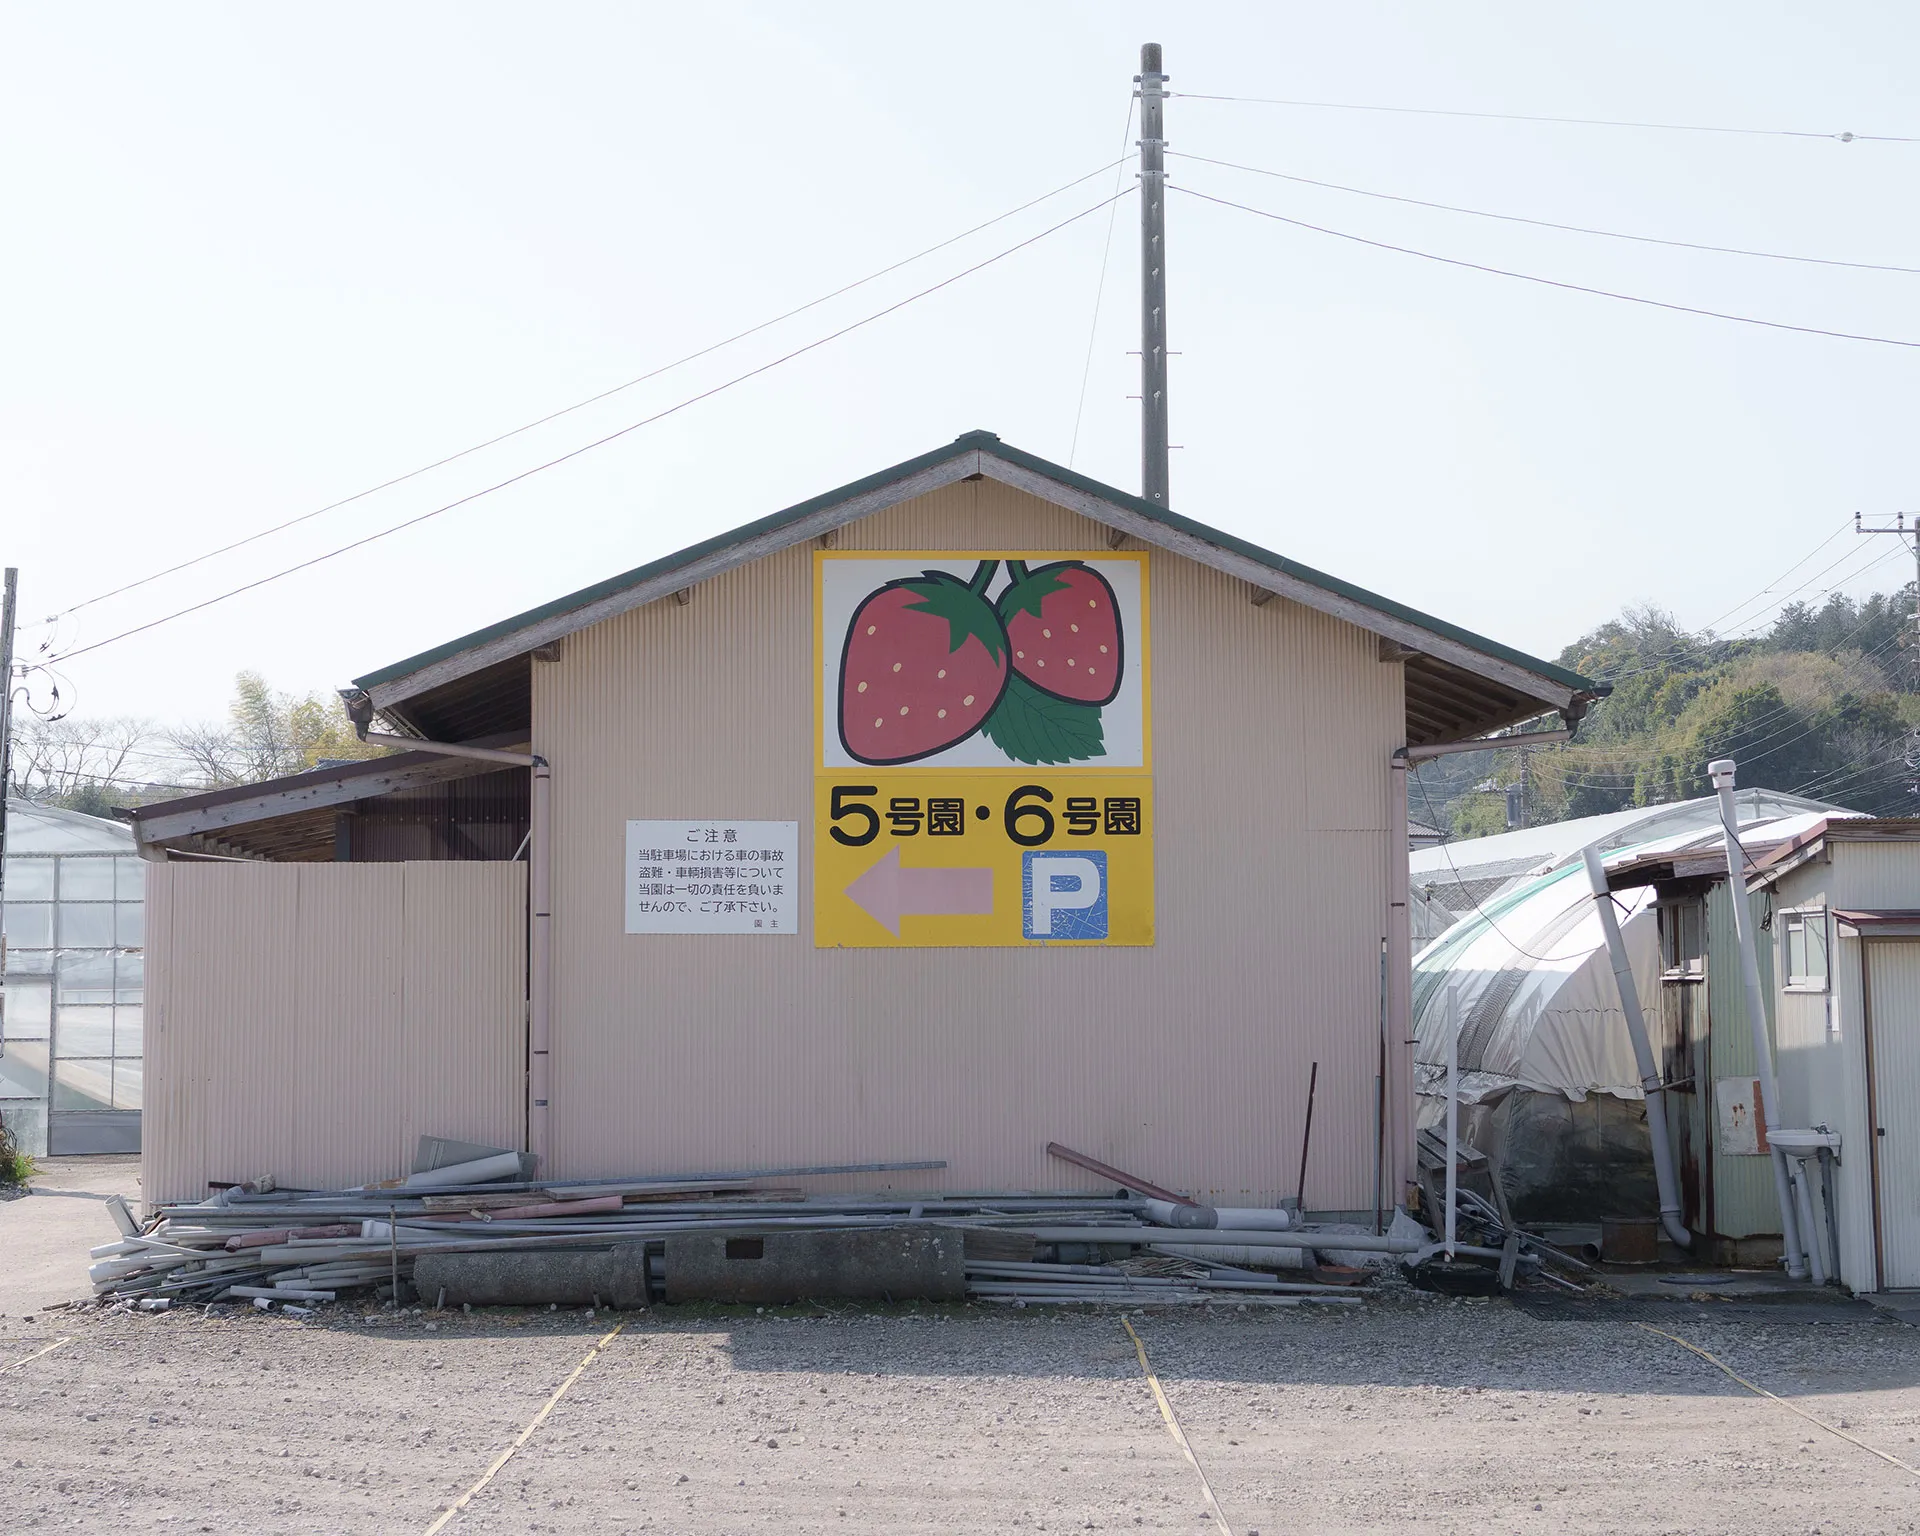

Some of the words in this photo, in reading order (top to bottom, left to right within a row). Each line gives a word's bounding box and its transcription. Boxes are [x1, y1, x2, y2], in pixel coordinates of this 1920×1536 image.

[829, 785, 1141, 847] 5号園・6号園
[686, 828, 738, 843] ご注意
[638, 849, 784, 862] 当駐車場における車の事故
[638, 883, 784, 896] 当園は一切の責任を負いま
[1031, 857, 1101, 935] P
[638, 900, 778, 914] せんので、ご了承下さい。
